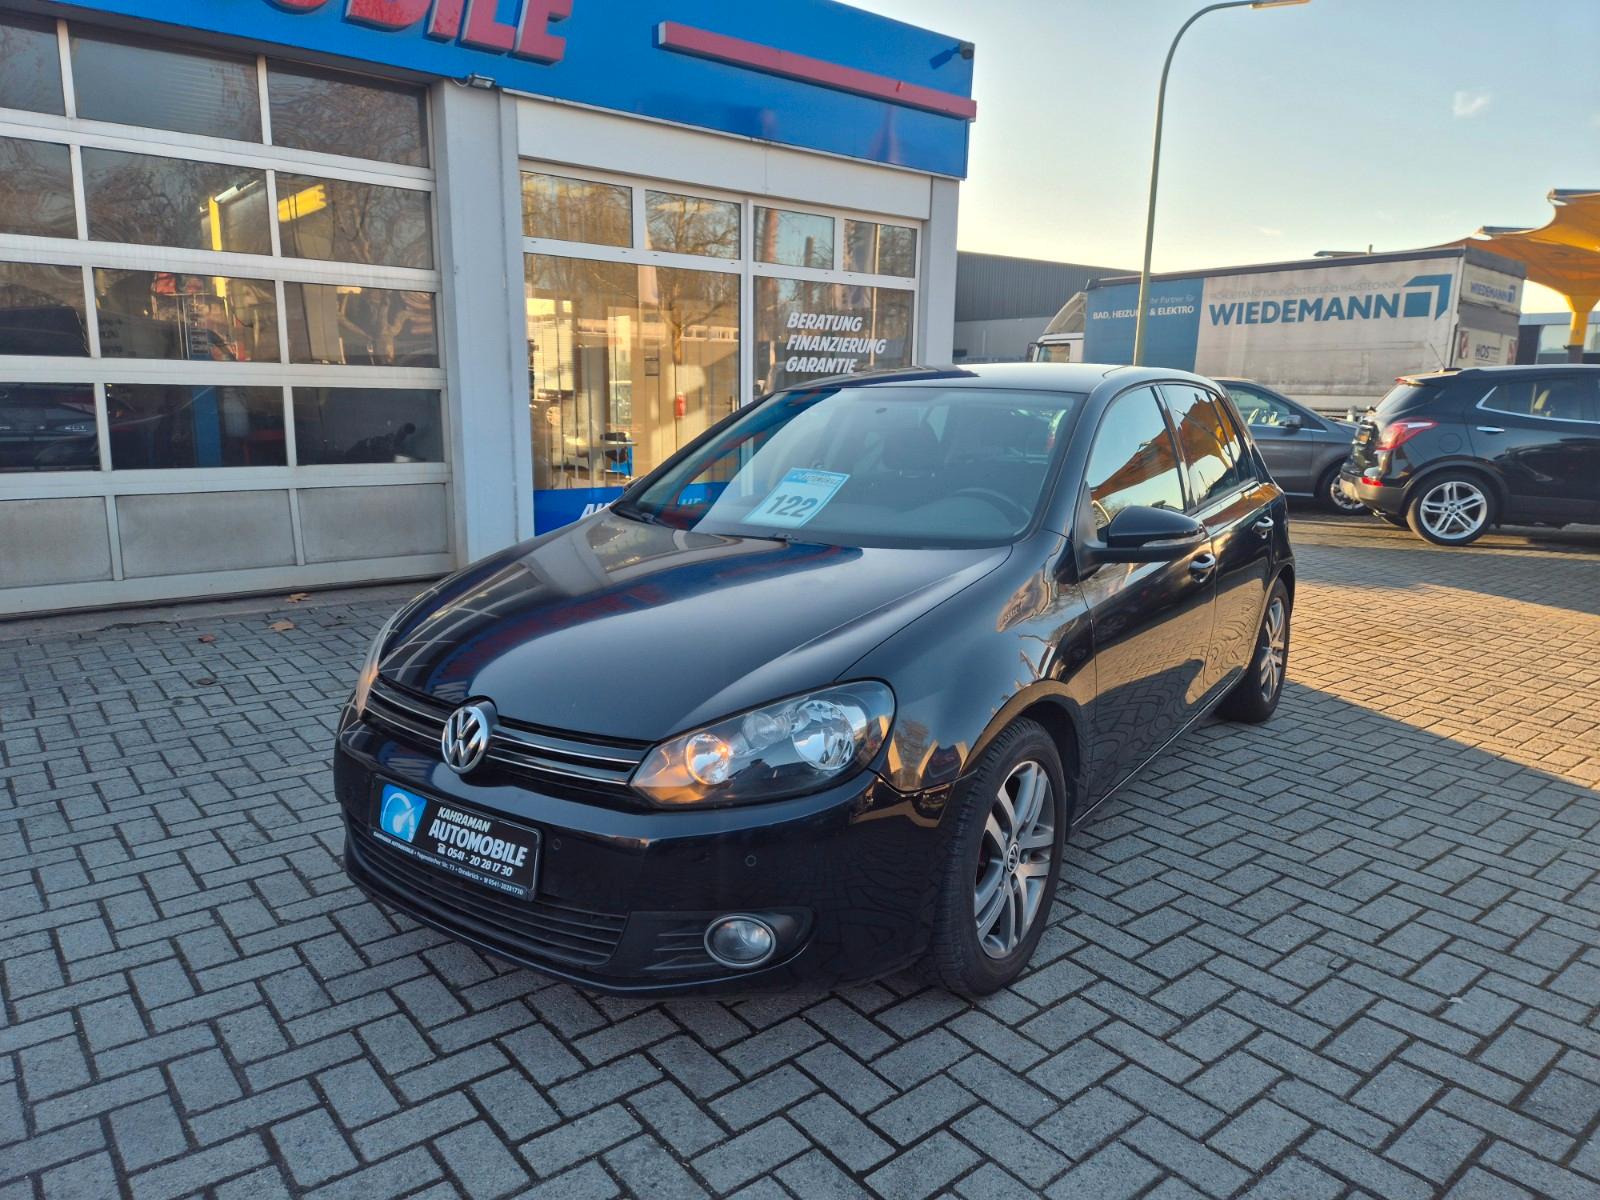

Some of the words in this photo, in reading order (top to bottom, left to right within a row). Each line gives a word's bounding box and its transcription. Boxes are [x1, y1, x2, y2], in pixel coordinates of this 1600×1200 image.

[1158, 305, 1195, 316] ELEKTRO
[1208, 292, 1400, 326] WIEDEMANN
[787, 312, 863, 332] BERATUNG
[786, 334, 887, 355] FINANZIERUNG
[785, 356, 858, 374] GARANTIE
[766, 494, 819, 518] 122
[437, 806, 491, 833] KAHRAMAN
[428, 818, 529, 868] AUTOMOBILE
[447, 847, 465, 861] 0541
[469, 854, 480, 866] 20
[480, 859, 492, 870] 28
[492, 862, 501, 873] 17
[501, 866, 513, 877] 30
